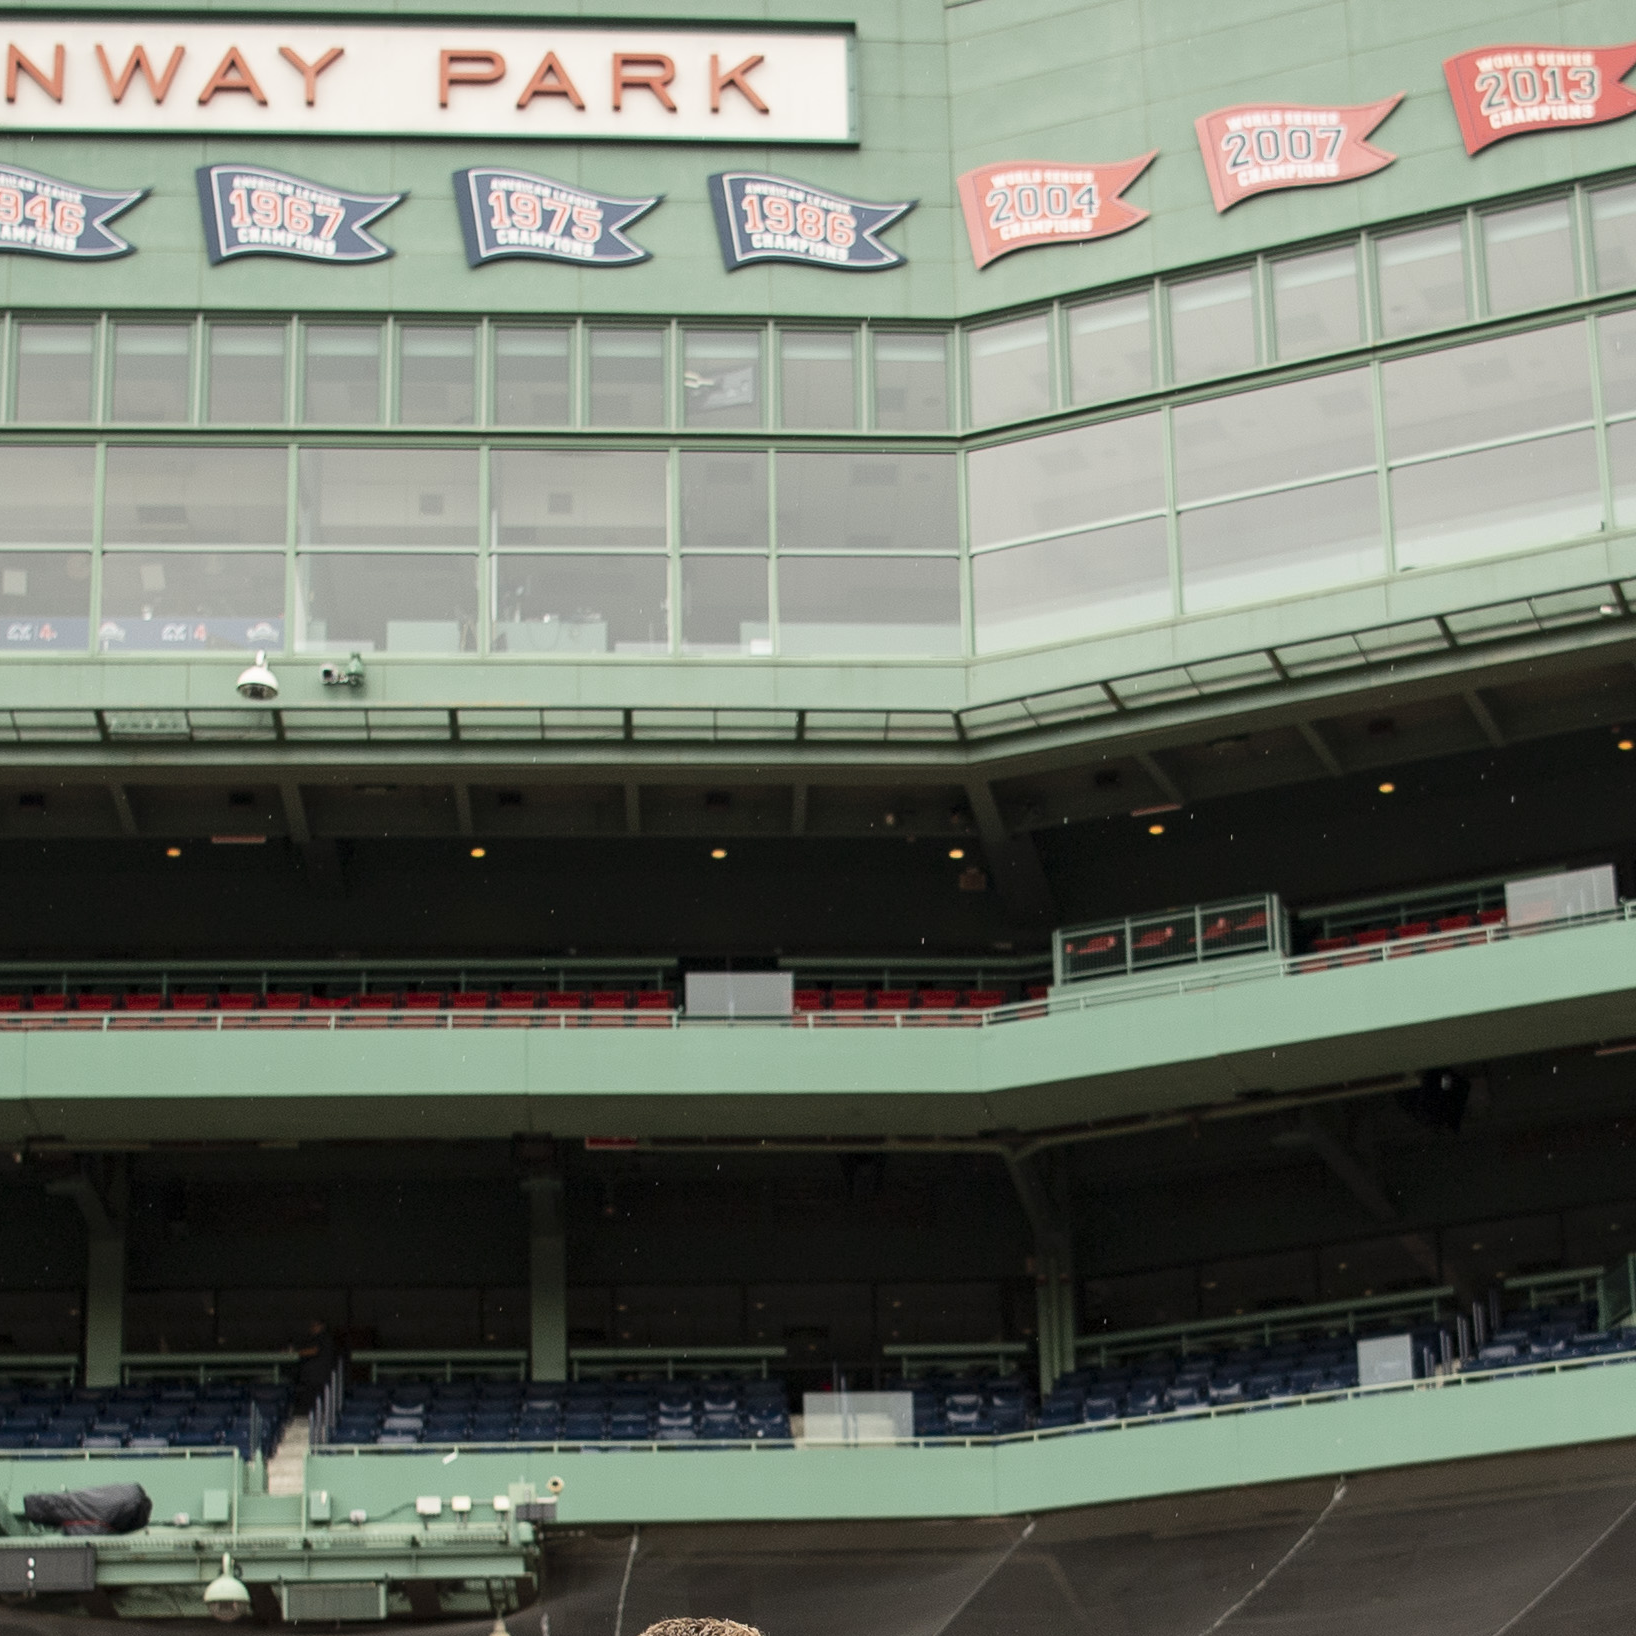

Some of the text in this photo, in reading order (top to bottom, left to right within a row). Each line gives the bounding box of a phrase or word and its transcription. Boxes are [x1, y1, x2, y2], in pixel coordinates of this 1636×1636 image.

[439, 46, 770, 115] PARK
[1475, 66, 1600, 117] 2013
[1489, 103, 1597, 130] CHAMPIONS
[1221, 125, 1344, 175] 2007
[229, 188, 346, 241] 1967
[488, 190, 604, 244] 1975
[741, 195, 857, 249] 1986
[986, 183, 1100, 229] 2004
